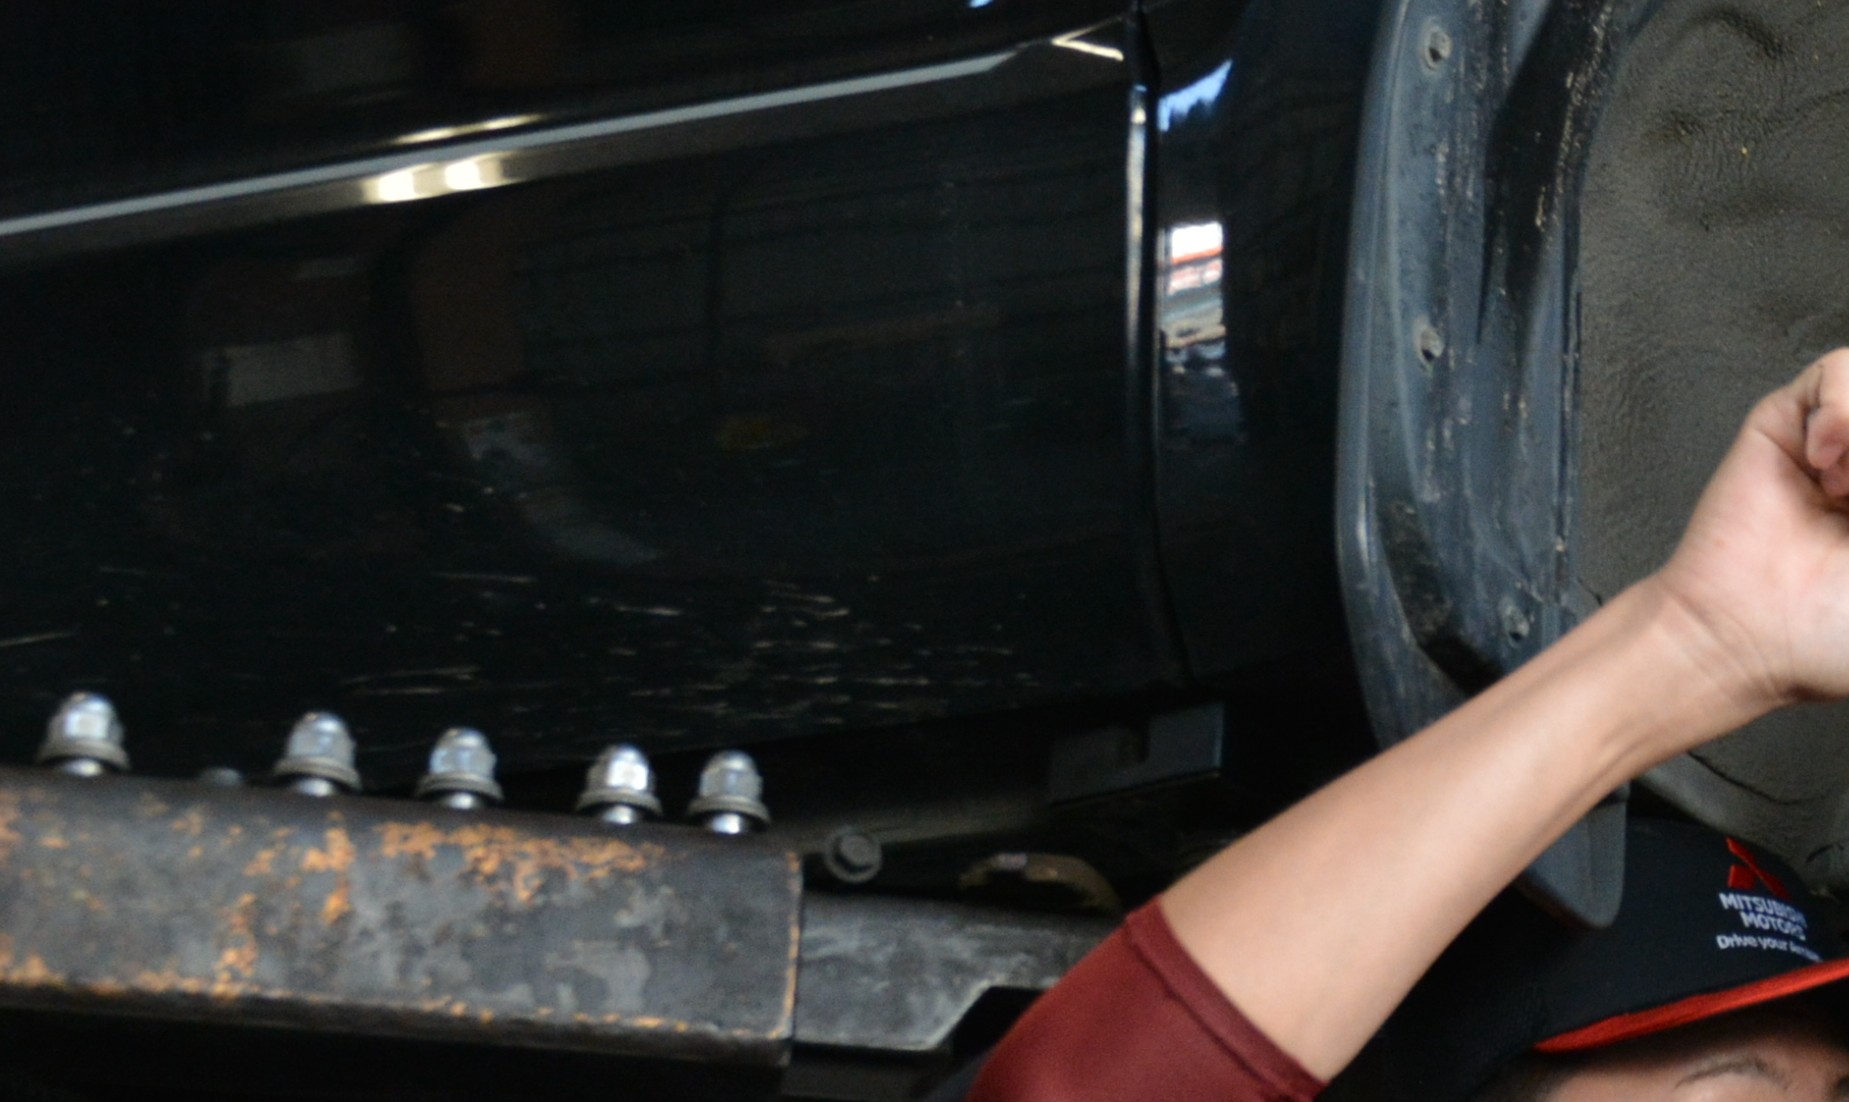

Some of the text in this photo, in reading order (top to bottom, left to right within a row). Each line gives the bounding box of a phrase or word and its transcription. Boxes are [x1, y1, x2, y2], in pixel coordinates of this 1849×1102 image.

[1739, 911, 1806, 941] MOTORS
[1716, 933, 1788, 951] Drive your
